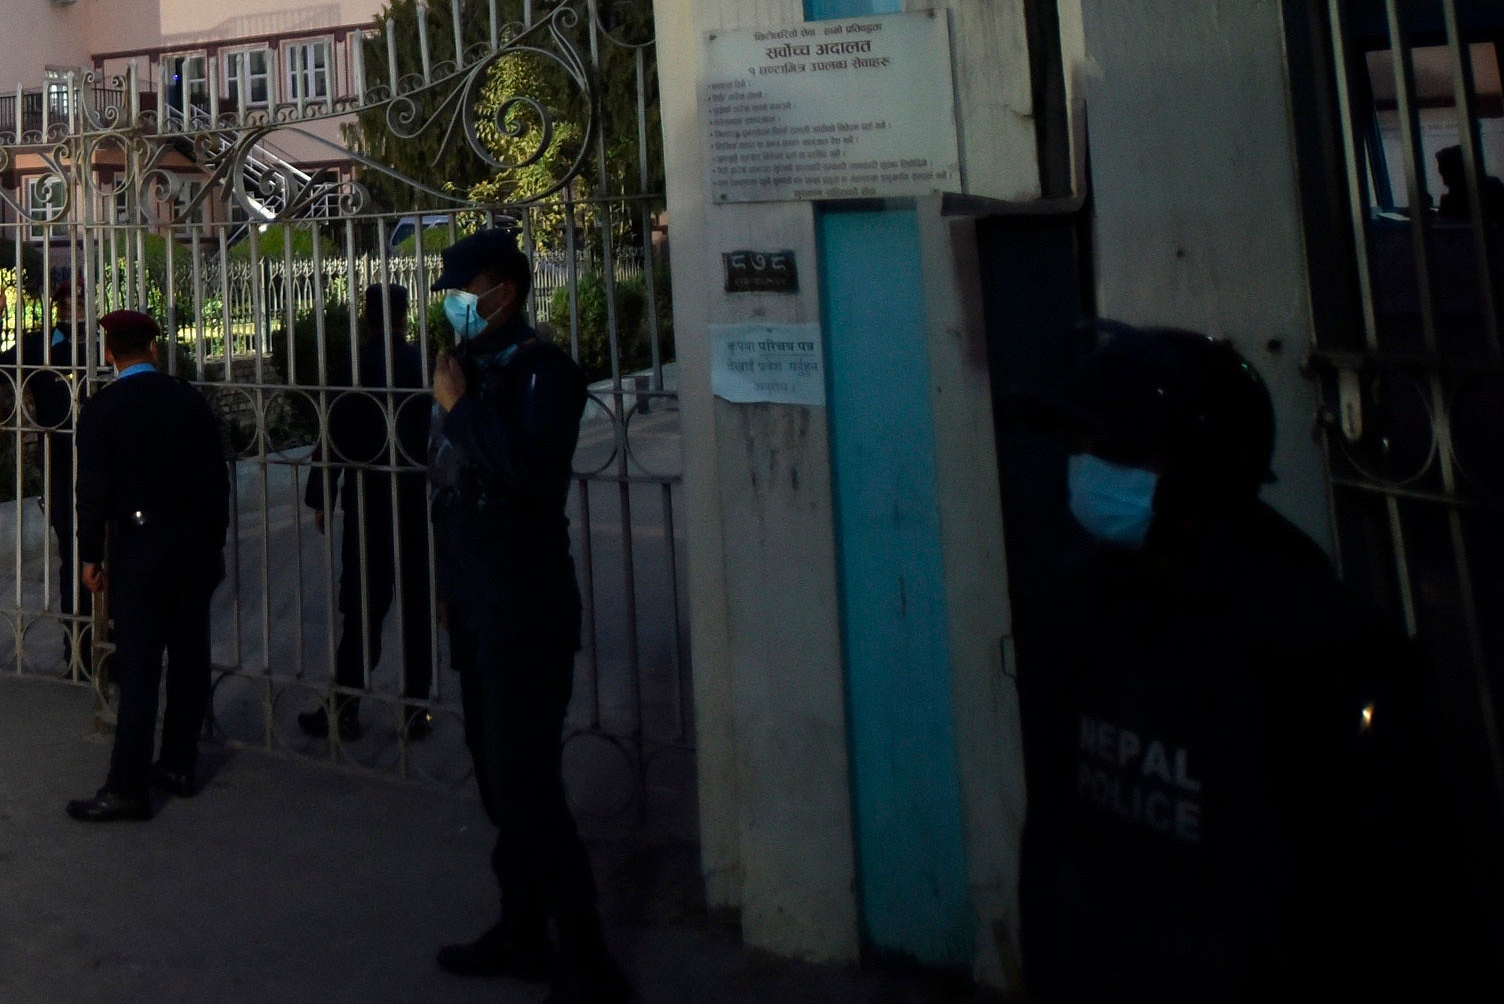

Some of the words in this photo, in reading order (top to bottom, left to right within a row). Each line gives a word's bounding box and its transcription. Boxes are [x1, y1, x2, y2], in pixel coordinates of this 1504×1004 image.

[766, 43, 811, 60] सर्वोच्च
[816, 40, 871, 56] अदालत
[1078, 713, 1202, 793] NEPAL
[1077, 760, 1201, 844] POLICE
